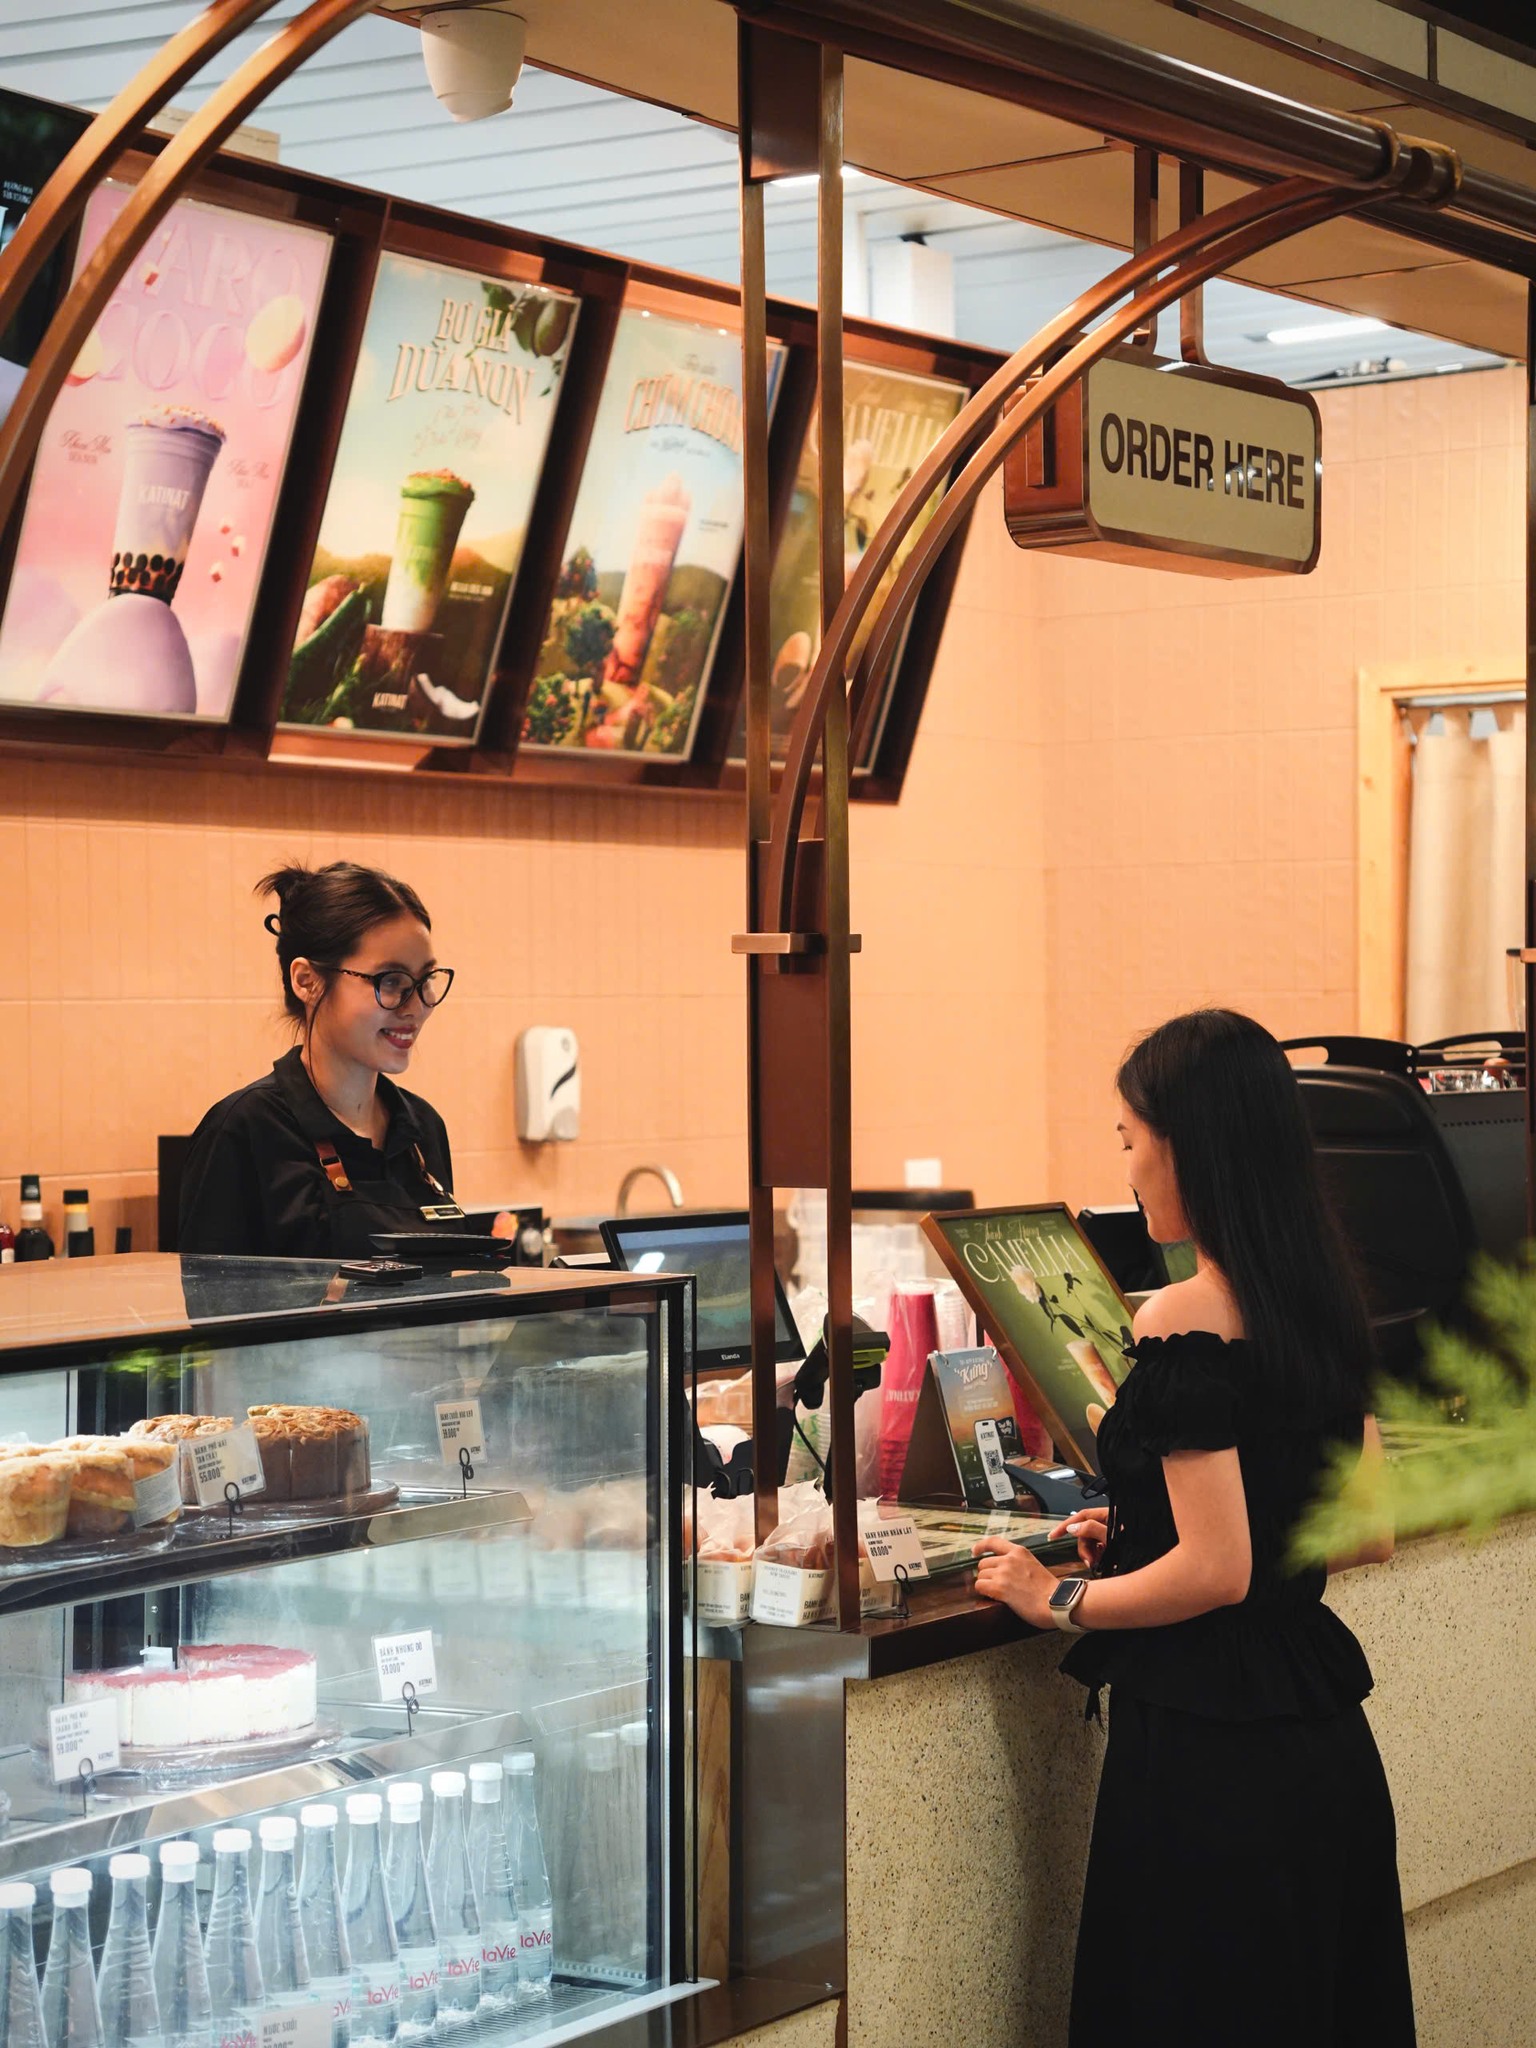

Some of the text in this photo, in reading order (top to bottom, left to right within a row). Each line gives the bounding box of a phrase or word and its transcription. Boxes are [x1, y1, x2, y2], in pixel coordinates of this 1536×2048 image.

[1101, 412, 1304, 509] ORDER HERE
[963, 1234, 1091, 1283] CAMELLIA
